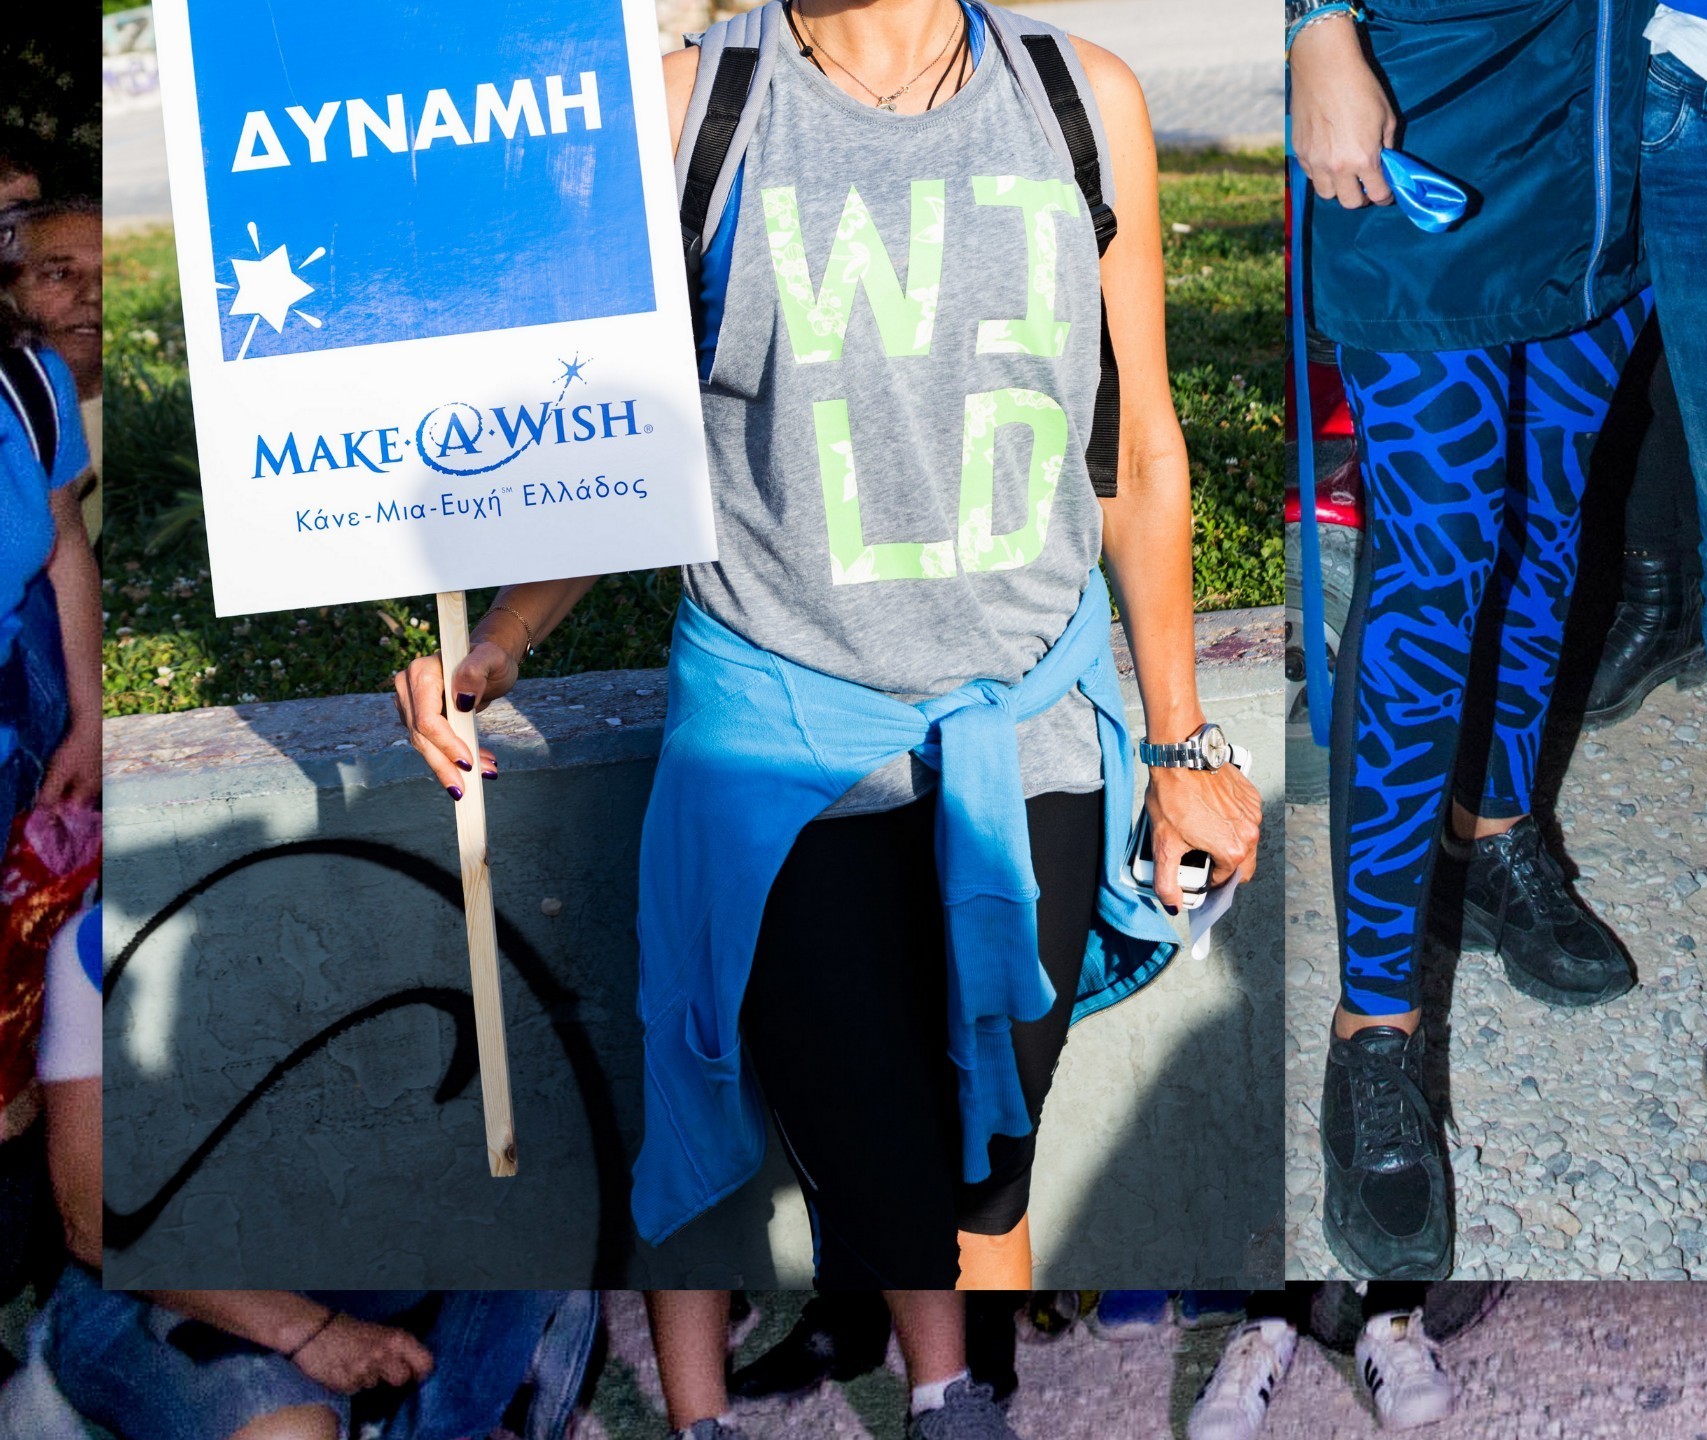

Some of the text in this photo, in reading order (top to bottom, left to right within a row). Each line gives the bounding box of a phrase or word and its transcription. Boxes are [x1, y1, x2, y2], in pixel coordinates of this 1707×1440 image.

[231, 71, 603, 173] ΔΥΝΑΜΗ
[252, 426, 403, 479] MAKE
[296, 492, 500, 533] Κάνε-Μια-Ευχή
[523, 475, 648, 507] Ελλάδος
